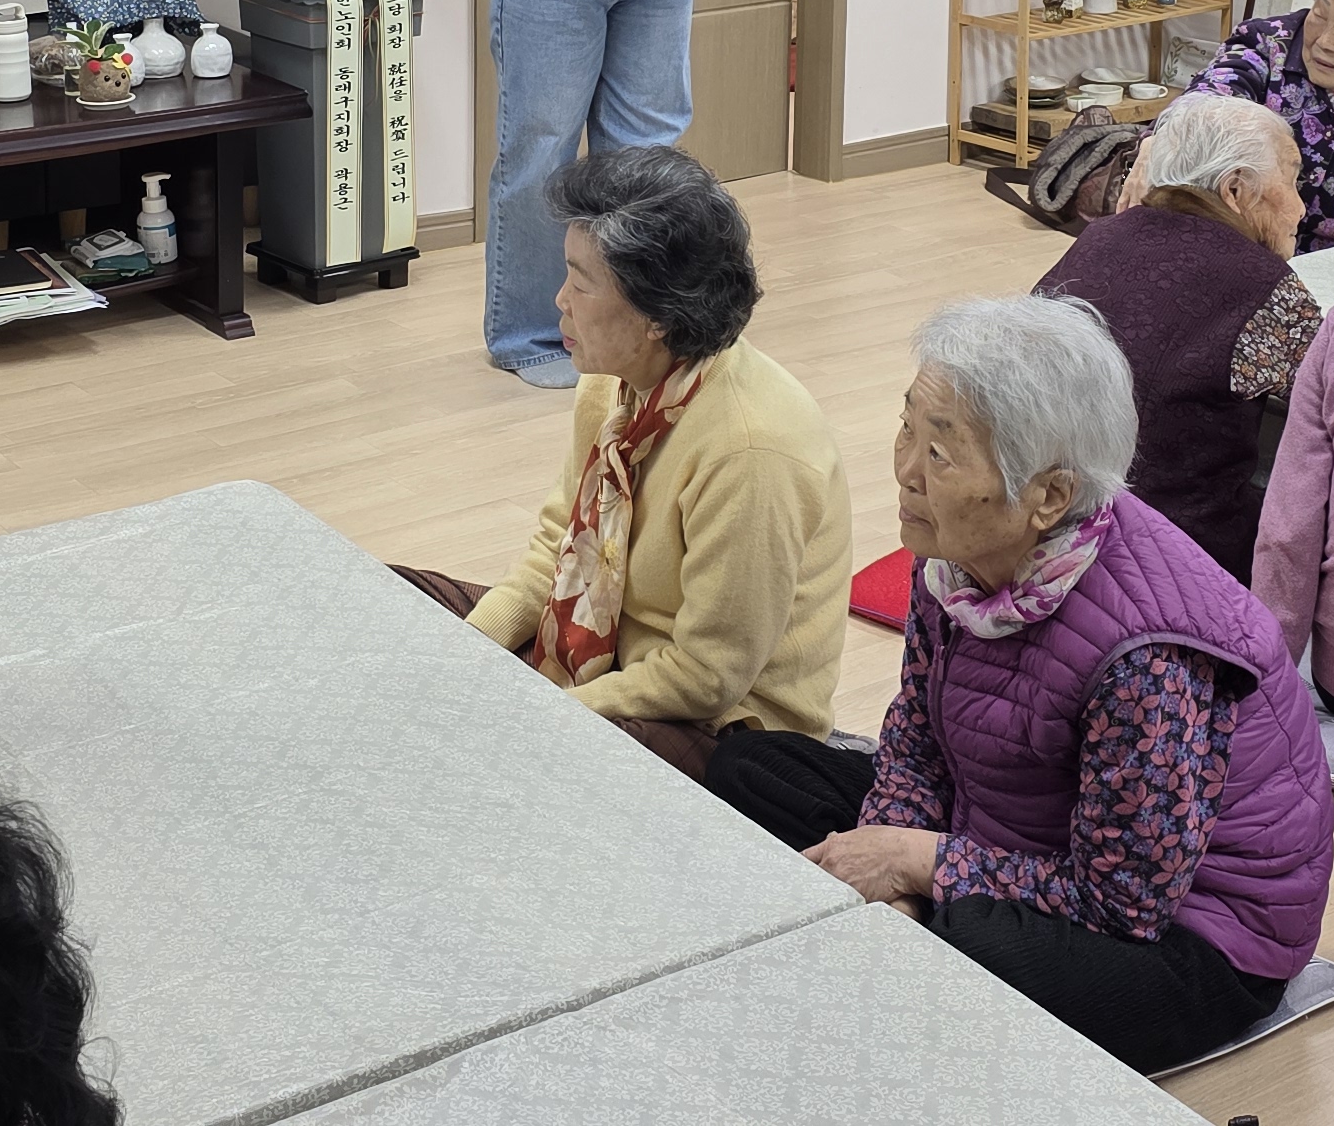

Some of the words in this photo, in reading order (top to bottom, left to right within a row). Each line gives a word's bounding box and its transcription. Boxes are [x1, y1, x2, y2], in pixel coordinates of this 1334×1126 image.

[386, 23, 406, 49] 회장
[387, 61, 408, 102] 就任을
[333, 66, 356, 153] 동래구지회장
[389, 115, 409, 142] 祝賀
[333, 167, 355, 210] 곽용근
[389, 149, 411, 205] 드립니다
